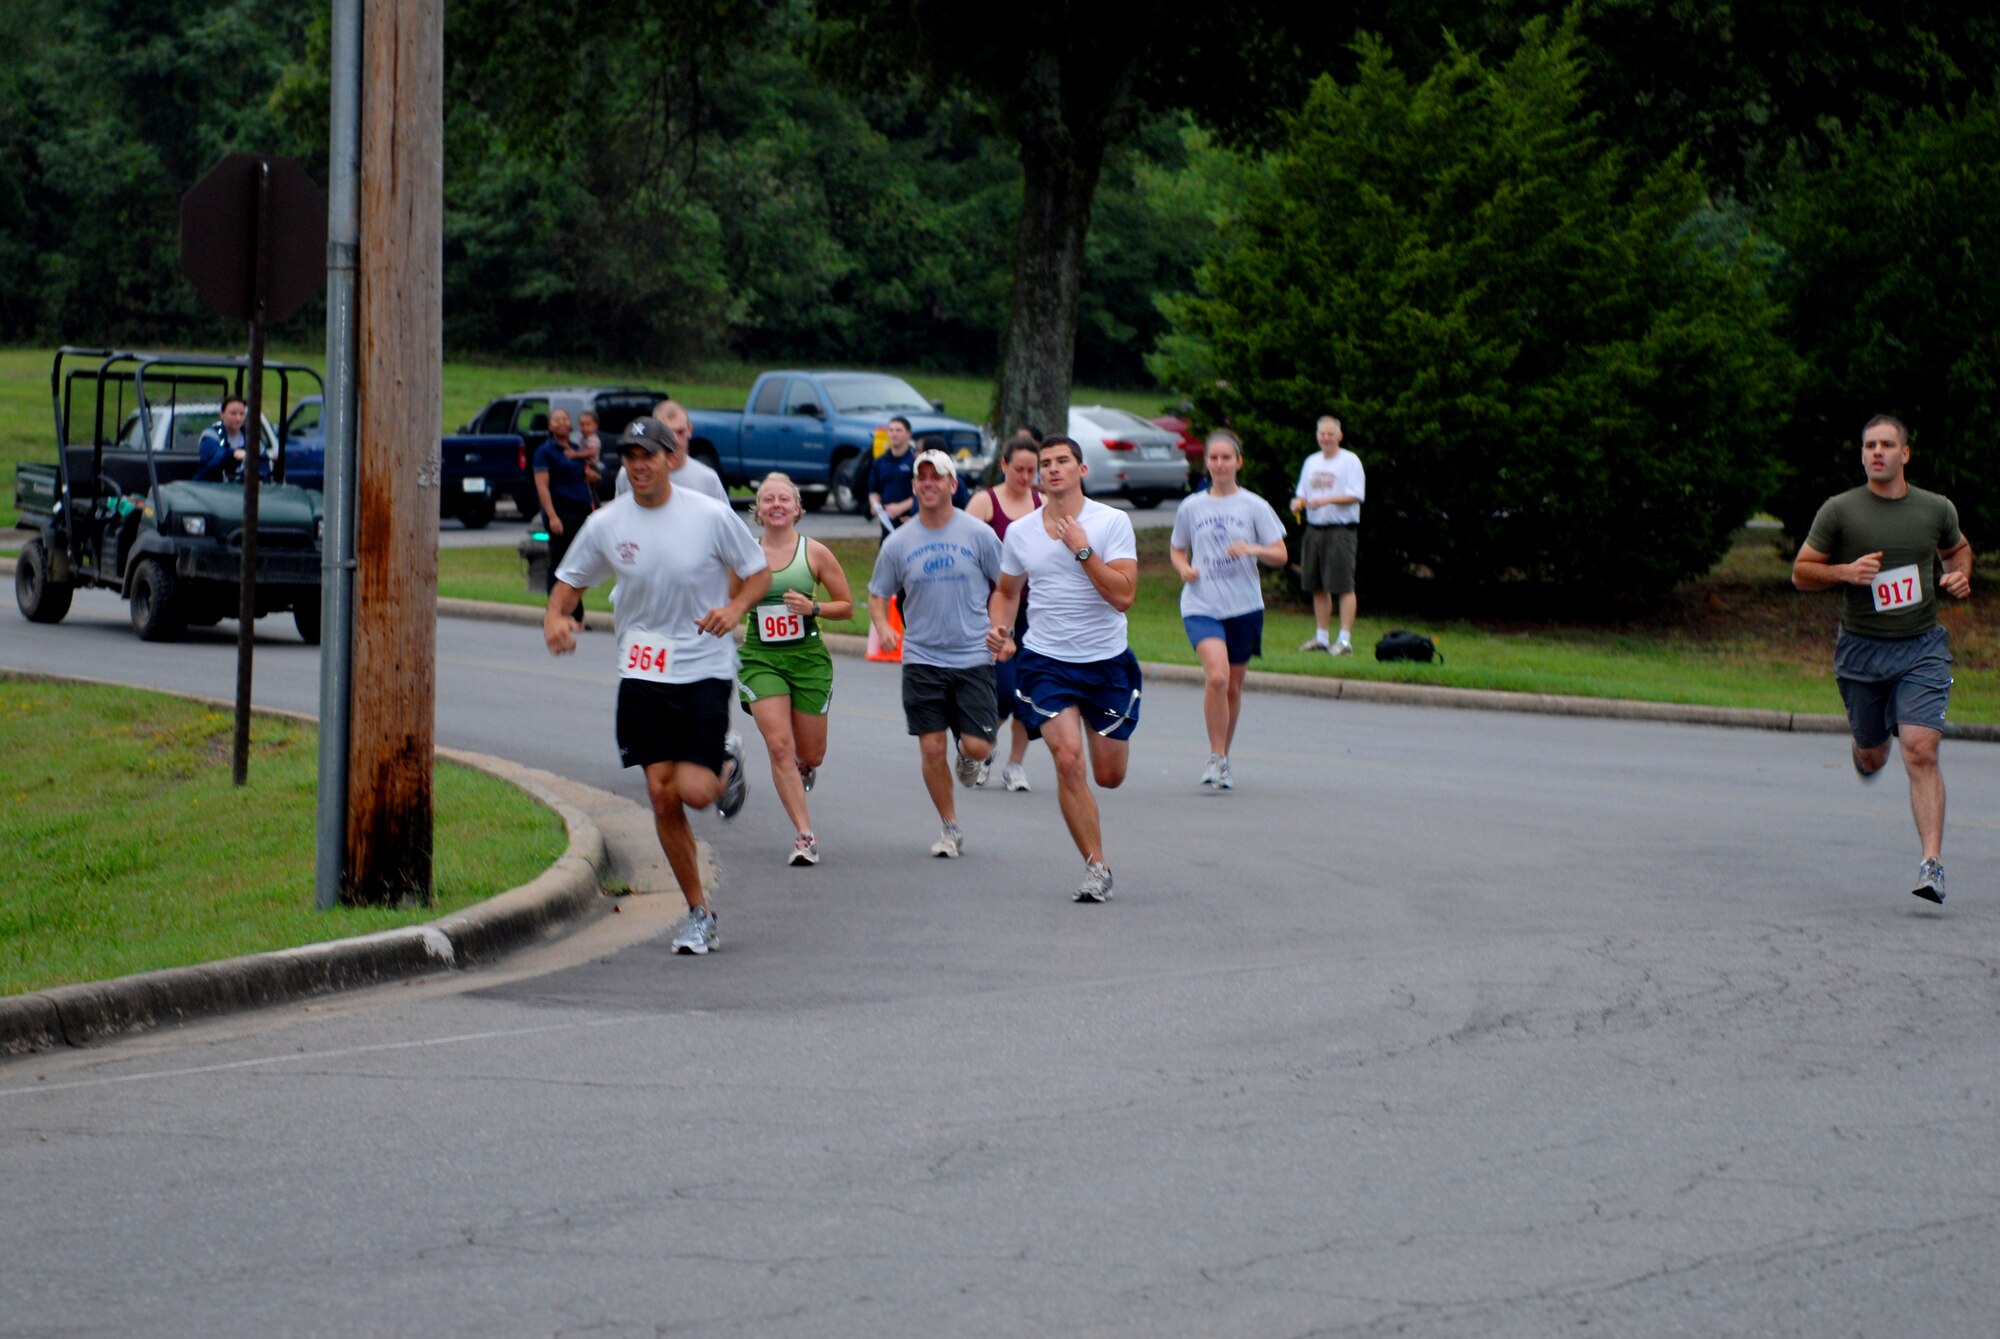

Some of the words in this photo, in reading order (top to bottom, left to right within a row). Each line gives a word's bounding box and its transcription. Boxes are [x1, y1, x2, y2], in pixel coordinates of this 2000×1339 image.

[1878, 577, 1913, 606] 917
[765, 614, 799, 637] 965
[627, 644, 666, 673] 964
